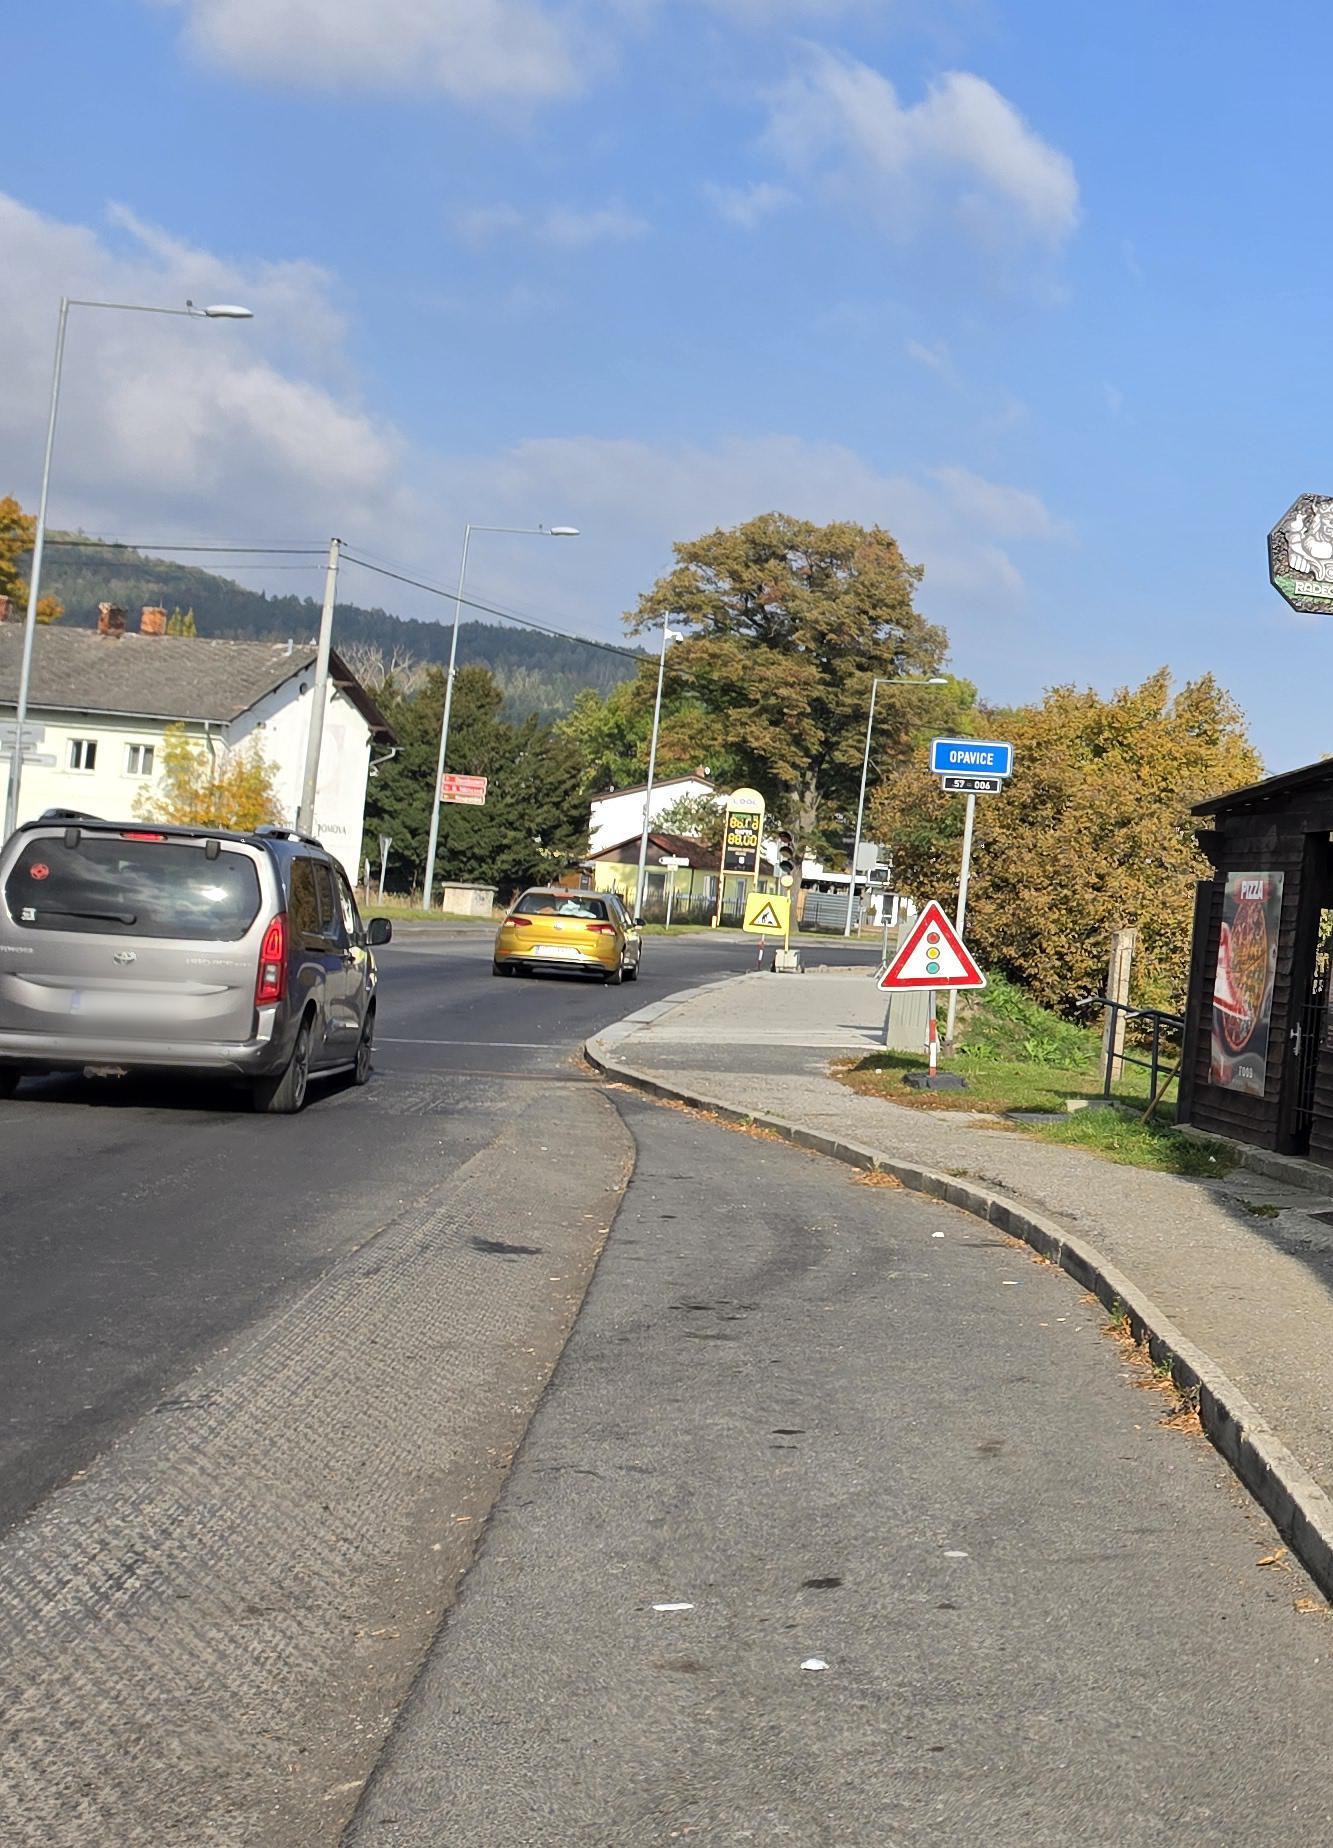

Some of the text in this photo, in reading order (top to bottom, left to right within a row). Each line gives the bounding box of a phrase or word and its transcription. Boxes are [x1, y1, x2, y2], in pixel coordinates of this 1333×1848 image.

[949, 750, 995, 766] OPAVICE
[953, 779, 966, 788] 57
[974, 781, 991, 790] 006
[1241, 880, 1264, 900] PIZZA
